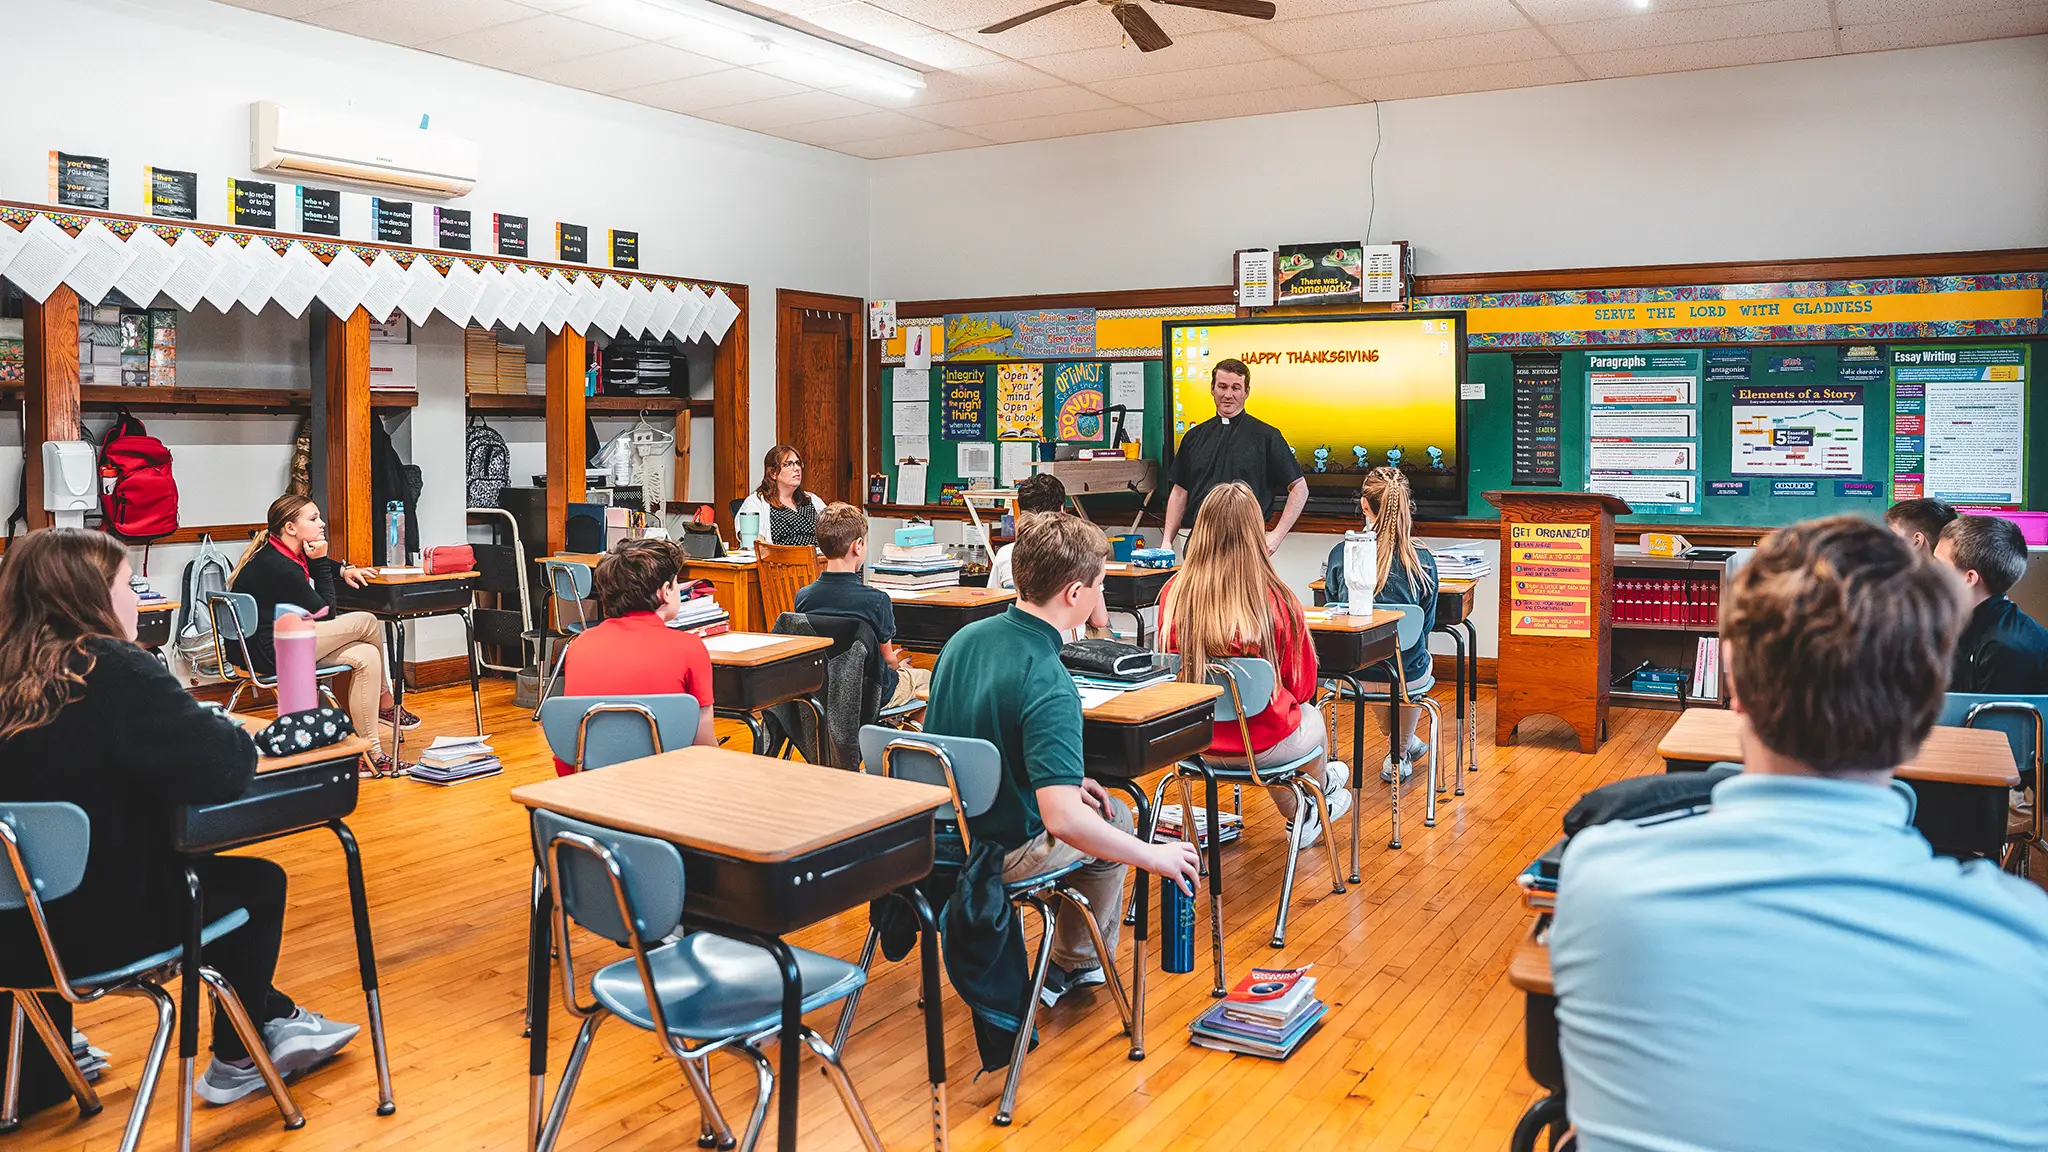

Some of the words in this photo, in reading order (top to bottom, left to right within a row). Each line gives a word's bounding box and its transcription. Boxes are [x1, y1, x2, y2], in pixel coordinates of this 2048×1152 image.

[67, 160, 91, 168] you're
[67, 168, 81, 177] you
[157, 174, 172, 182] then
[67, 184, 84, 192] your
[67, 192, 81, 200] you
[157, 196, 173, 204] than
[256, 192, 274, 200] recline
[304, 198, 318, 206] who
[236, 206, 245, 214] lay
[304, 212, 323, 220] whom
[388, 220, 410, 228] direction
[1300, 278, 1322, 286] There
[1291, 280, 1352, 294] homework?
[1594, 308, 1636, 320] SERVE
[1646, 307, 1676, 319] THE
[1690, 306, 1726, 318] LORD
[1740, 304, 1780, 316] WITH
[1793, 300, 1873, 314] GLADNESS
[1018, 323, 1032, 332] You
[1020, 333, 1033, 342] You
[1048, 334, 1068, 344] Steer
[1068, 332, 1094, 343] Yourself
[1241, 352, 1282, 364] HAPPY
[1286, 350, 1380, 364] THANKSGIVING
[1895, 352, 1920, 364] Essay
[1922, 351, 1956, 363] Writing
[1590, 355, 1646, 370] Paragraphs
[1782, 358, 1802, 366] plot
[1058, 364, 1066, 372] THE
[1711, 366, 1745, 374] antagonist
[946, 369, 984, 381] Integrity
[1004, 372, 1028, 382] Open
[1012, 383, 1033, 392] your
[1080, 382, 1093, 390] the
[951, 388, 980, 400] doing
[1006, 392, 1032, 400] mind.
[1740, 390, 1797, 399] Elements
[1799, 389, 1810, 398] of
[1824, 388, 1857, 400] Story
[958, 400, 982, 412] right
[1004, 403, 1028, 413] Open
[952, 410, 978, 422] thing
[1005, 414, 1011, 422] a
[1014, 412, 1038, 422] book.
[1062, 394, 1100, 438] DONUT
[1536, 426, 1556, 434] LEADERS
[1776, 430, 1787, 444] 5
[1512, 526, 1531, 538] GET
[1536, 528, 1590, 538] ORGANIZED!
[1532, 552, 1547, 560] MAKE
